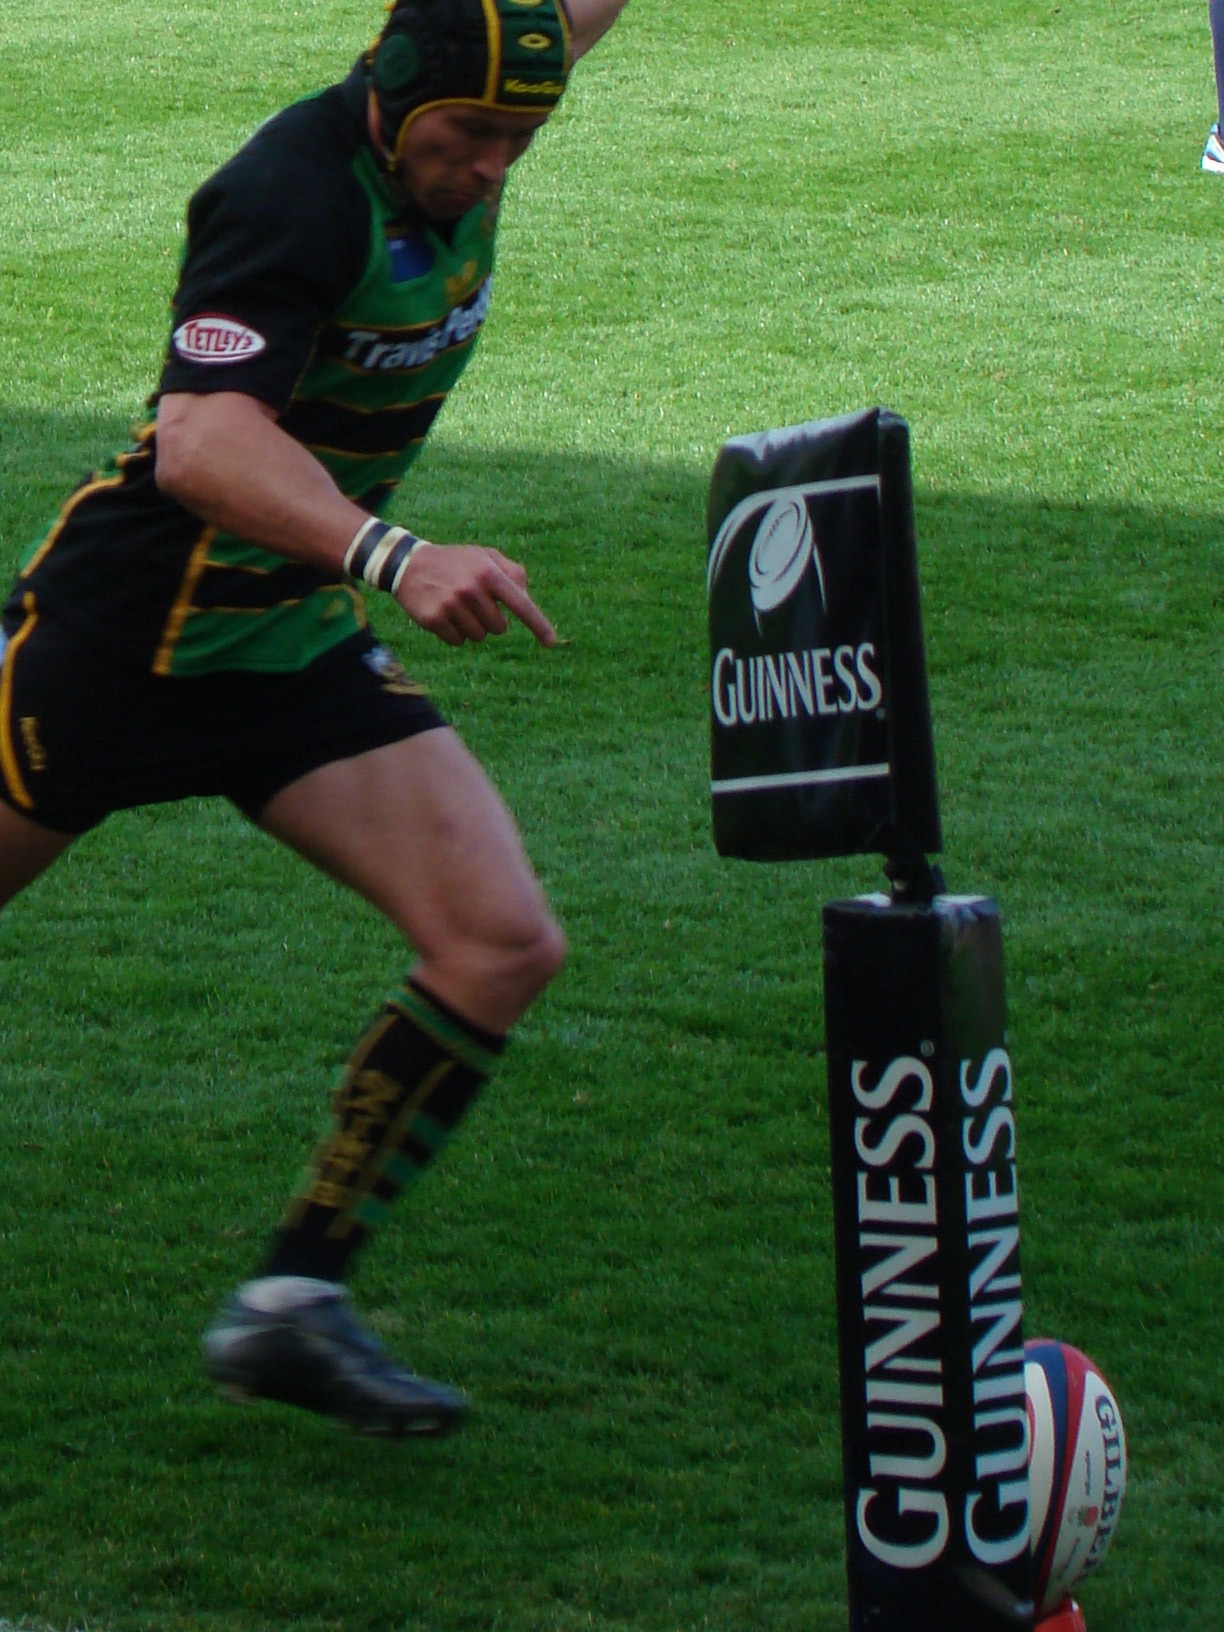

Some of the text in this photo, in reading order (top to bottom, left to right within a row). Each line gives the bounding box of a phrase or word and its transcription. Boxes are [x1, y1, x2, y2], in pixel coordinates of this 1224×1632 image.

[712, 642, 882, 726] GUINNESS
[850, 1054, 950, 1569] GUINNESS
[960, 1047, 1031, 1565] GUINNESS
